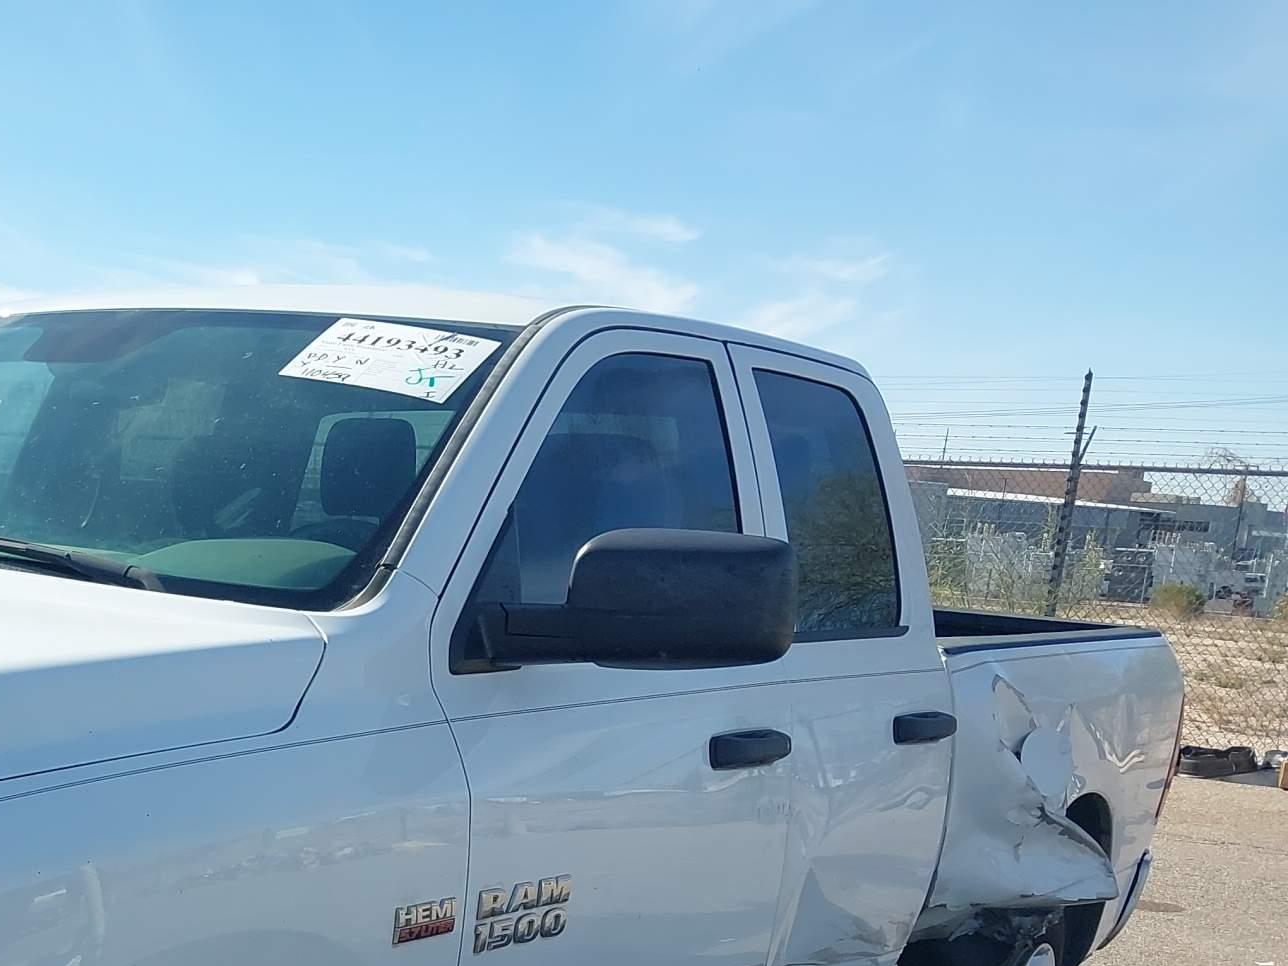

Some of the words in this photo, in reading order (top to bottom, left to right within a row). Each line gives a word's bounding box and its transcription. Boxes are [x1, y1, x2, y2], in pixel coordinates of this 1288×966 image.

[337, 331, 464, 360] 44193493
[395, 897, 457, 928] HEMI
[476, 874, 572, 920] RAM
[473, 906, 567, 954] 1500
